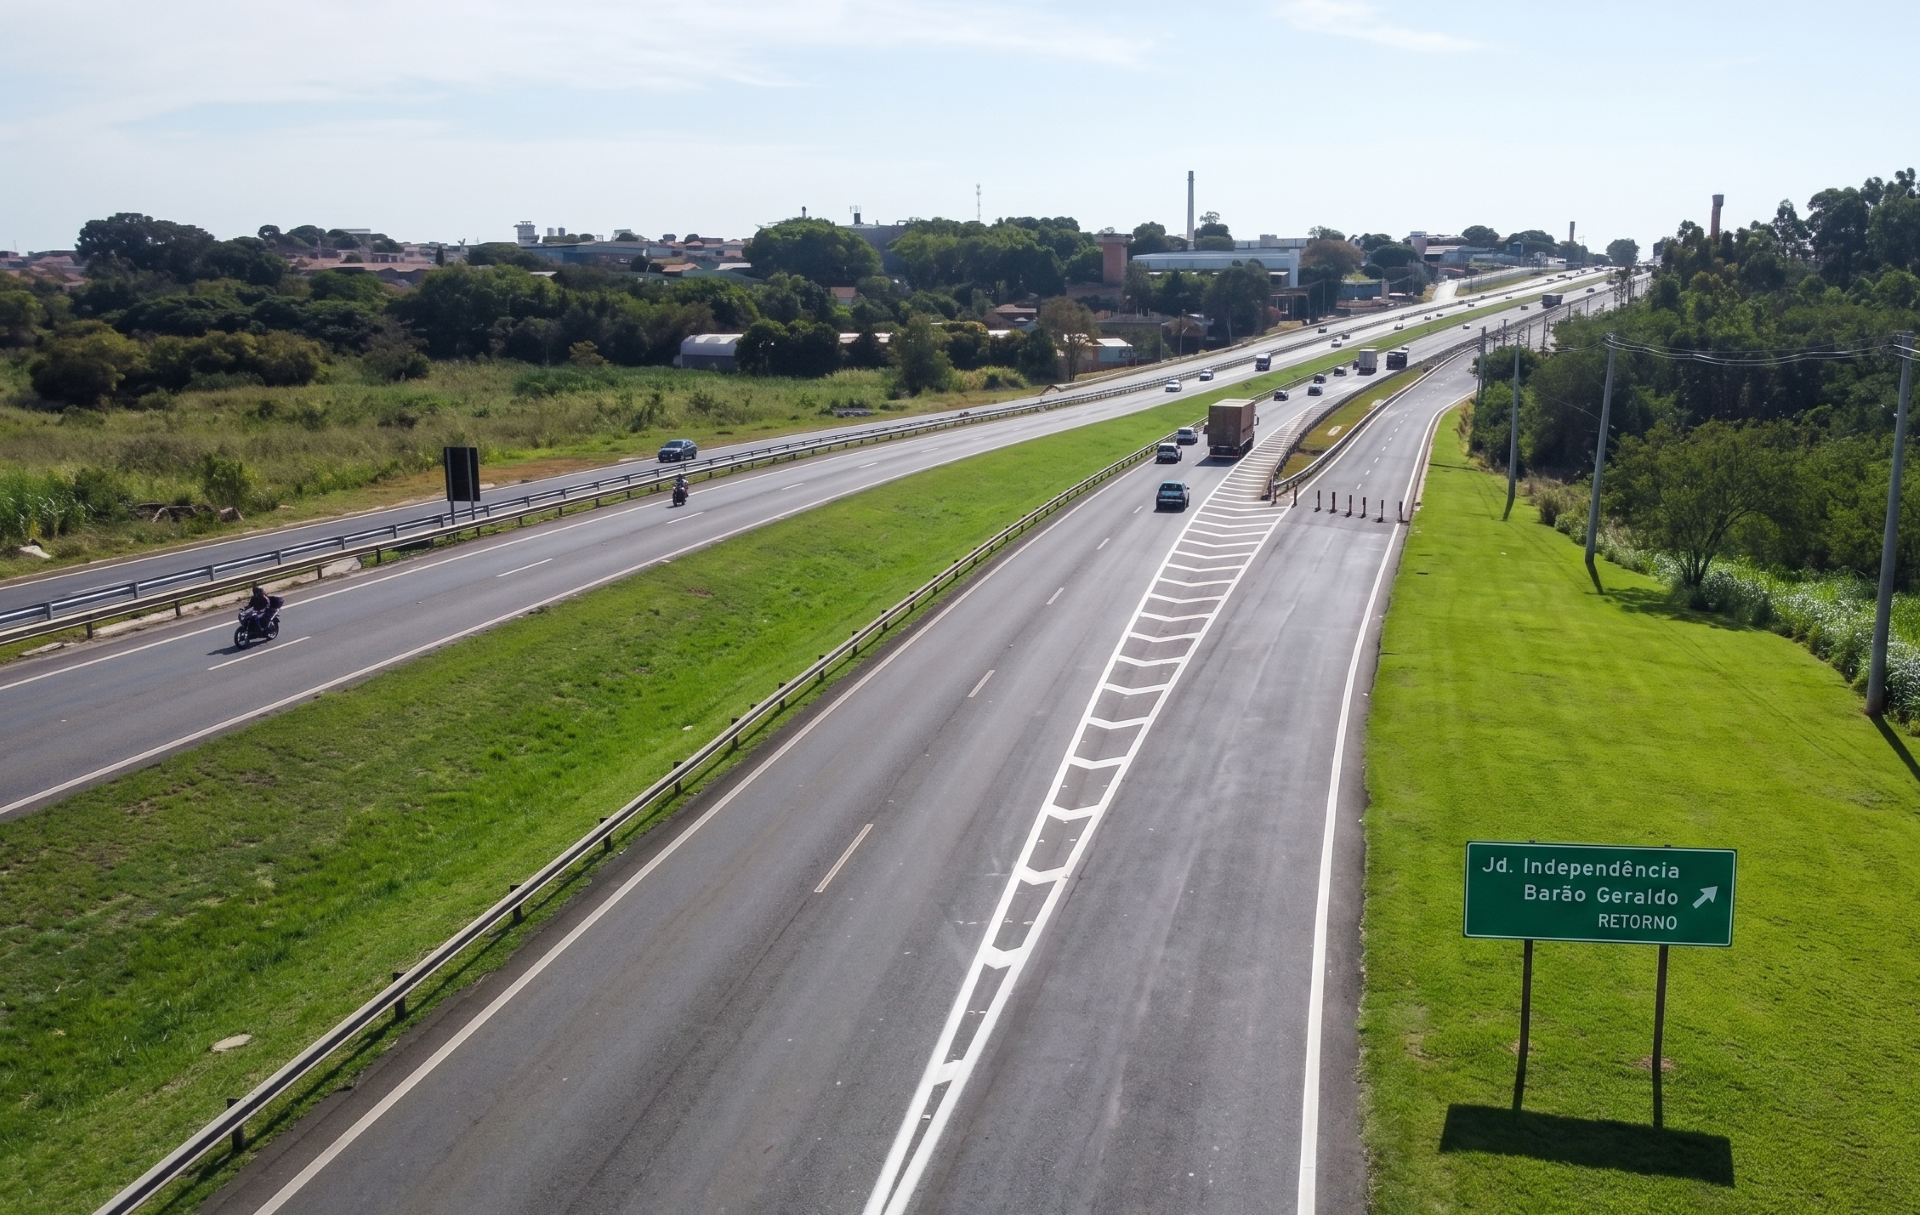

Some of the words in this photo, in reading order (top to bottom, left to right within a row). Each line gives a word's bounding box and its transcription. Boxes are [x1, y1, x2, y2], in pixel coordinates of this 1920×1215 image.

[1482, 856, 1513, 873] Jd.
[1523, 857, 1680, 880] Independência
[1524, 884, 1586, 903] Barão
[1596, 886, 1679, 905] Geraldo
[1598, 913, 1678, 930] RETORNO
